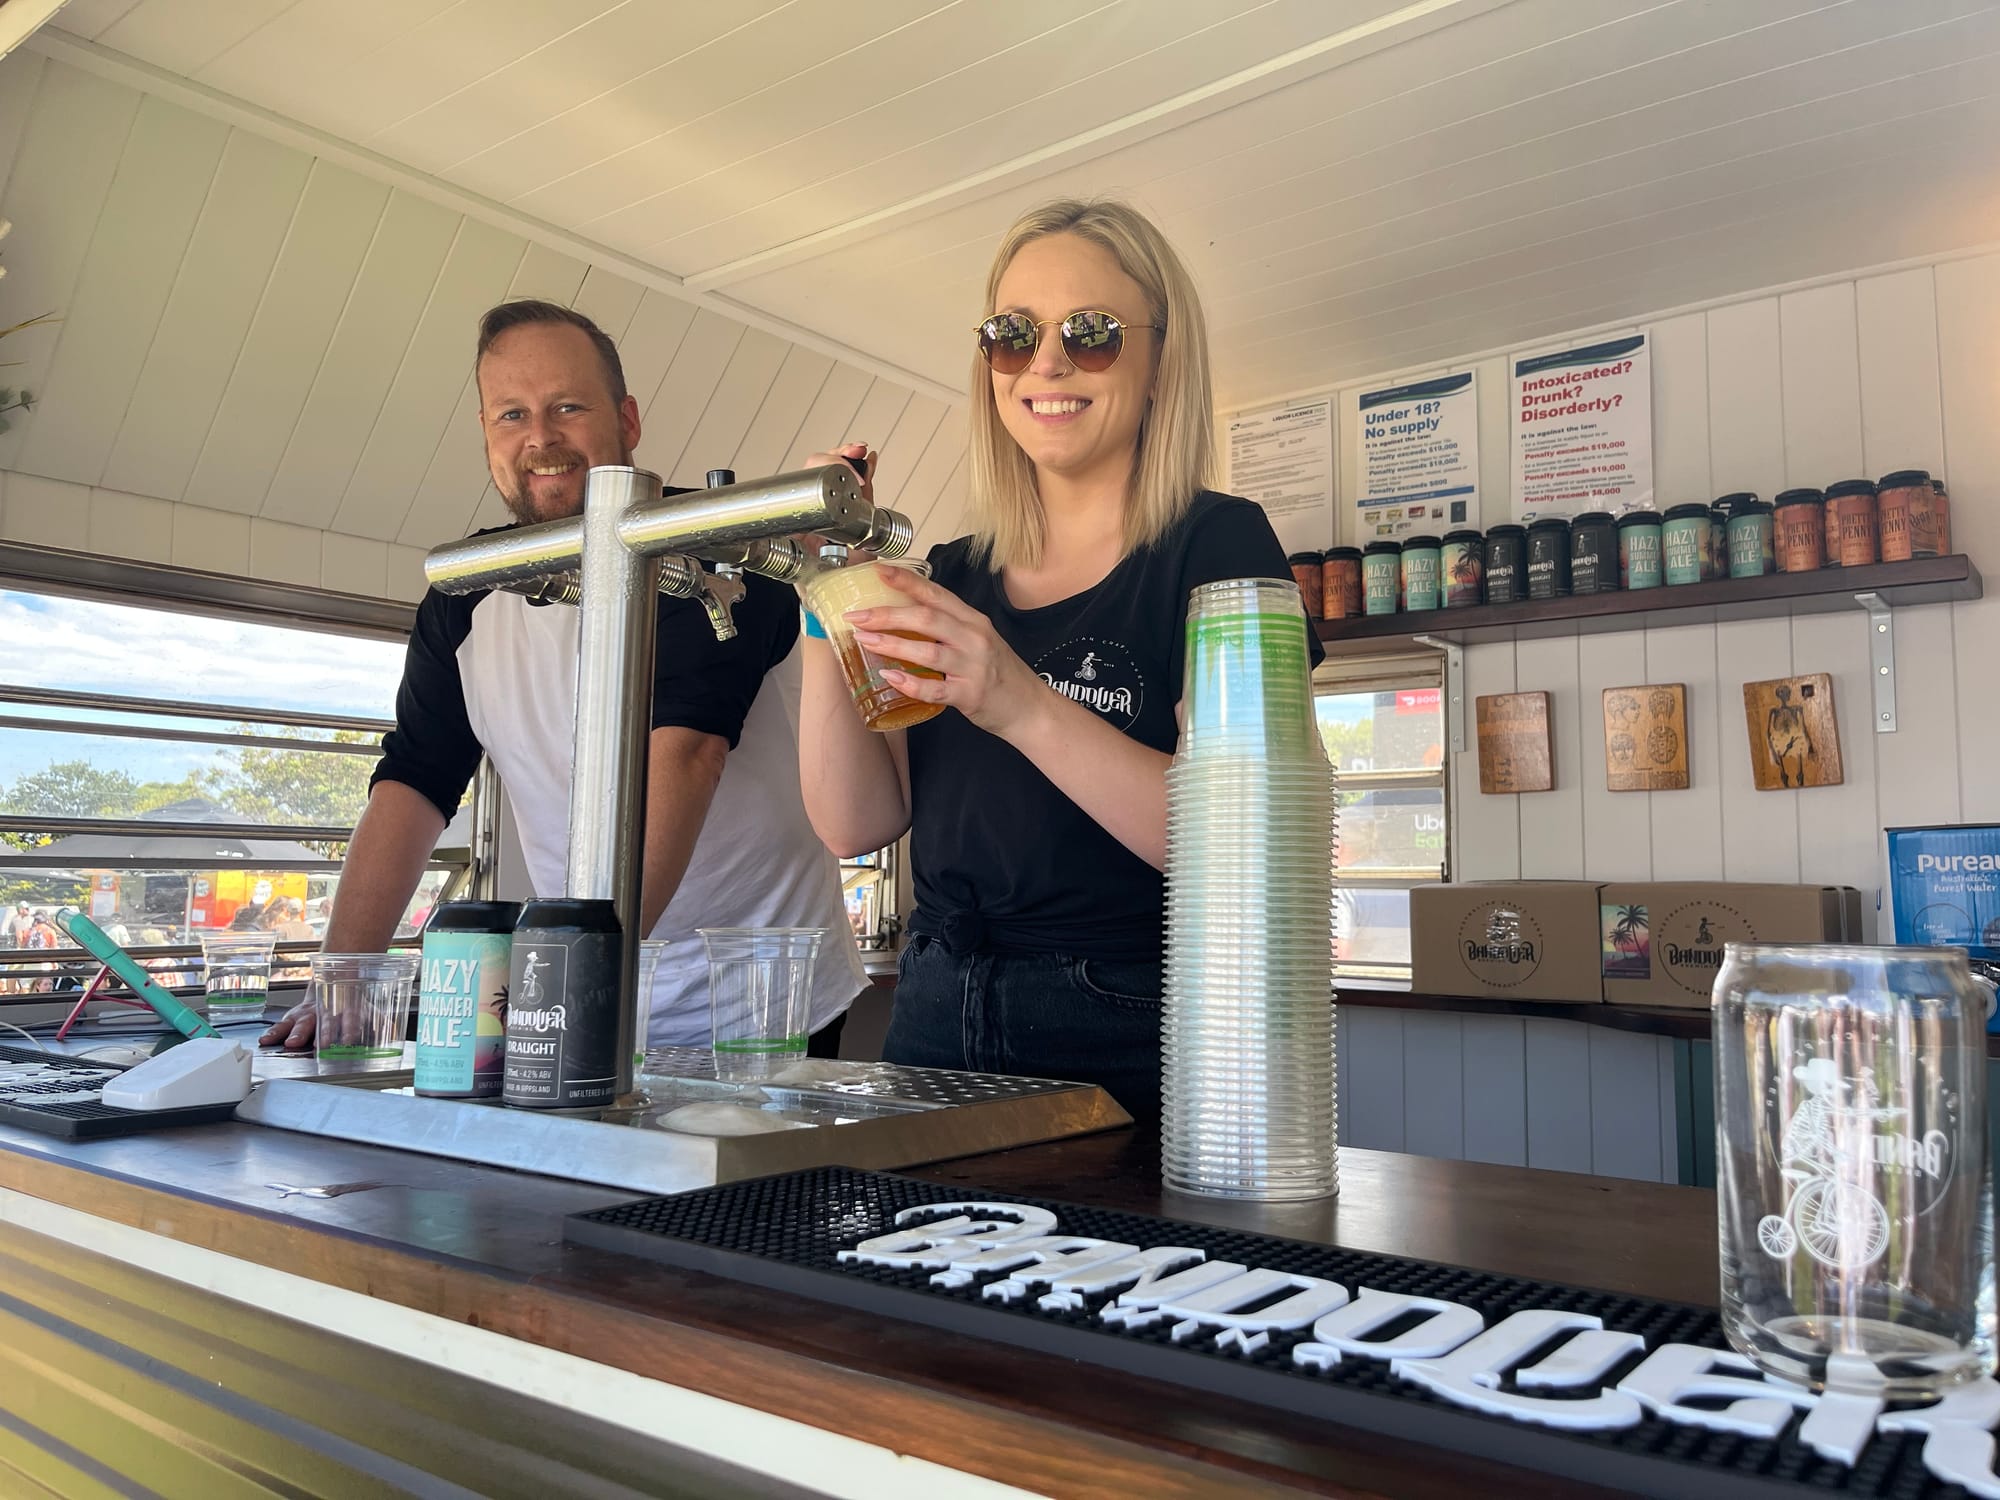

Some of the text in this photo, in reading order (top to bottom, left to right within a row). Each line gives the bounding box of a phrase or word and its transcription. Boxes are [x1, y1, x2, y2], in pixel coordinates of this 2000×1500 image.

[1523, 361, 1632, 392] Intoxicated?
[1522, 386, 1582, 408] Drunk?
[1366, 402, 1440, 424] Under 18?
[1522, 394, 1622, 423] Disorderly?
[1365, 428, 1386, 440] No
[1525, 440, 1625, 460] Penalty exceeds $19,000
[1525, 472, 1554, 481] Penalty
[1556, 468, 1589, 478] exceeds
[1592, 464, 1626, 473] $19,000
[1666, 528, 1696, 546] HAZY
[1729, 525, 1760, 543] HAZY
[1842, 525, 1871, 540] PENNY
[1630, 536, 1660, 552] HAZY
[1787, 534, 1815, 548] PENNY
[1367, 564, 1394, 578] HAZY
[1408, 559, 1435, 572] HAZY
[1414, 814, 1444, 831] Ube
[1415, 832, 1444, 848] Eat
[420, 958, 478, 994] HAZY
[508, 1040, 556, 1054] DRAUGHT
[539, 1070, 552, 1079] ABV
[521, 1084, 551, 1094] GIPPSLAND
[569, 1088, 600, 1098] UNFILTERED
